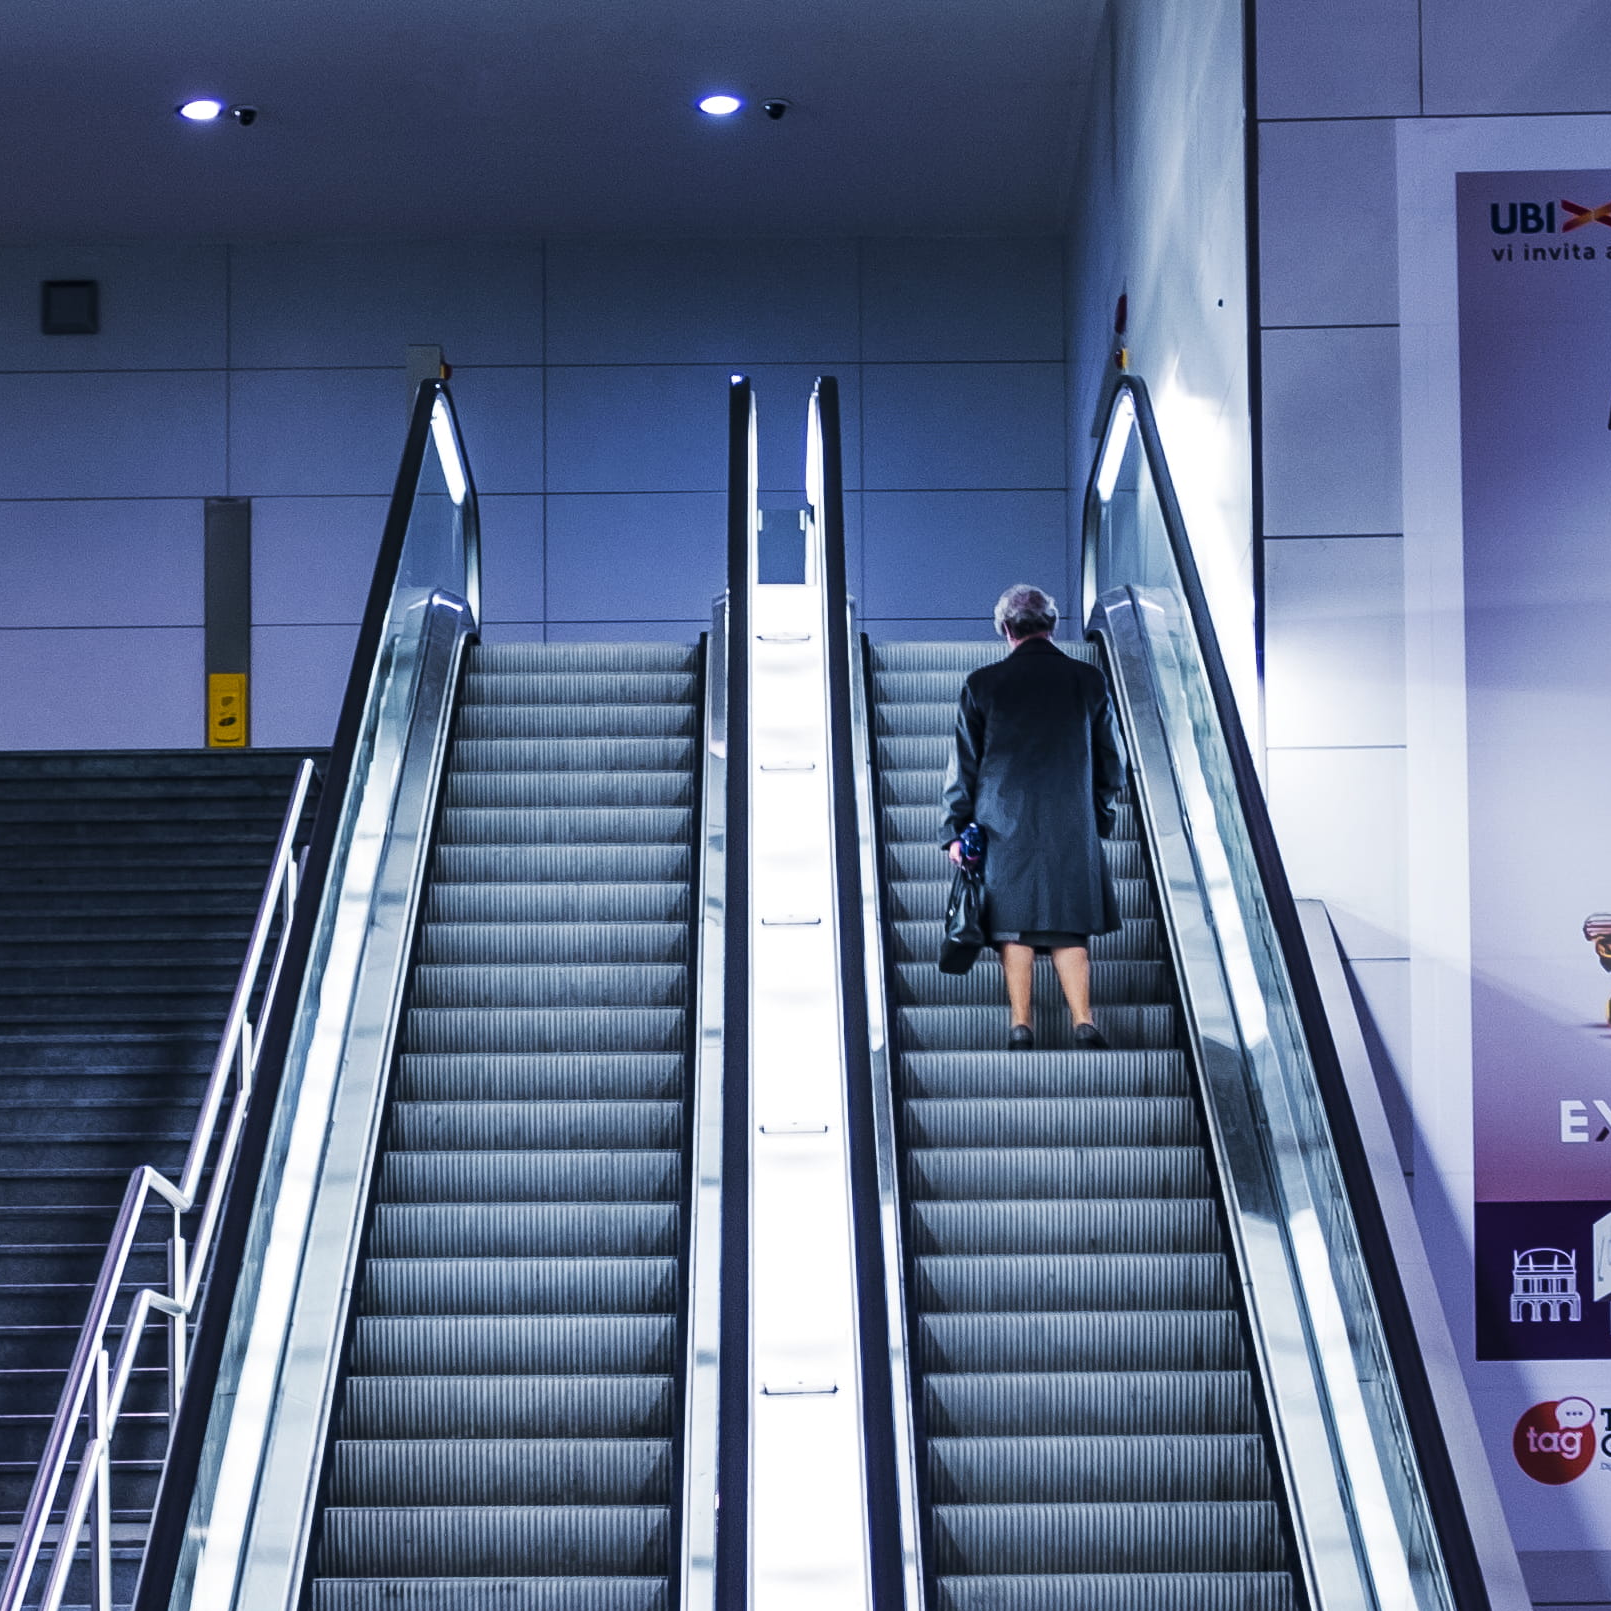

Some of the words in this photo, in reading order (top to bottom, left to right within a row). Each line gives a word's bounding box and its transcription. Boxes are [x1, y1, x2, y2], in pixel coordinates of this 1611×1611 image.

[1491, 201, 1556, 236] UBI
[1492, 243, 1513, 262] vi
[1523, 241, 1596, 262] invita
[1526, 1425, 1584, 1460] tag
